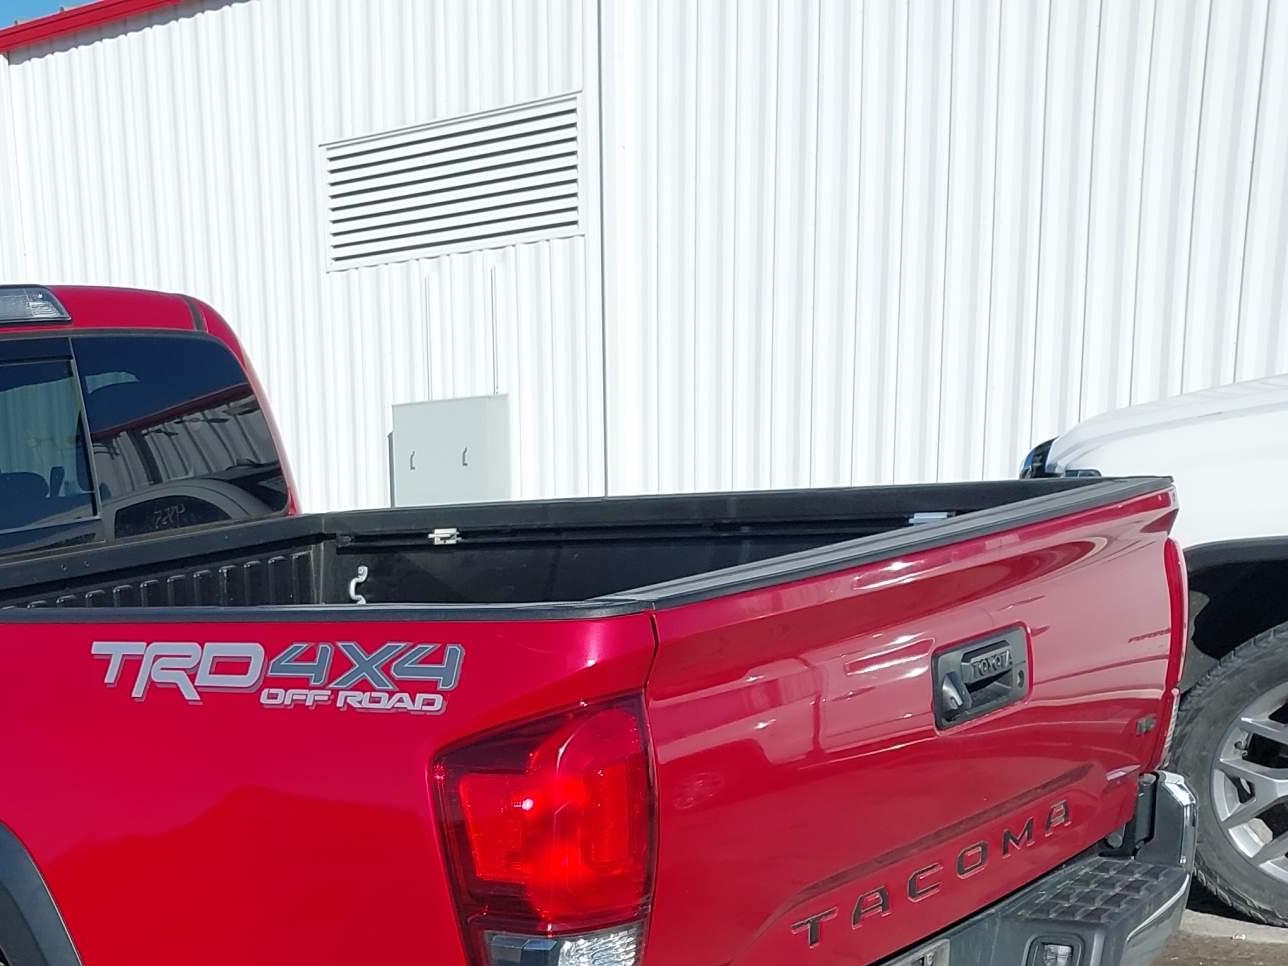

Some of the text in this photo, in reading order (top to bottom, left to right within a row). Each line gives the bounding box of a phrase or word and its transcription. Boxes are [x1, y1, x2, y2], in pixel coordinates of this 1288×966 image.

[91, 641, 465, 705] TRD 4X4
[971, 649, 1013, 679] TOYOTA
[260, 688, 448, 715] OFF ROAD
[791, 800, 1074, 949] TACOMA
